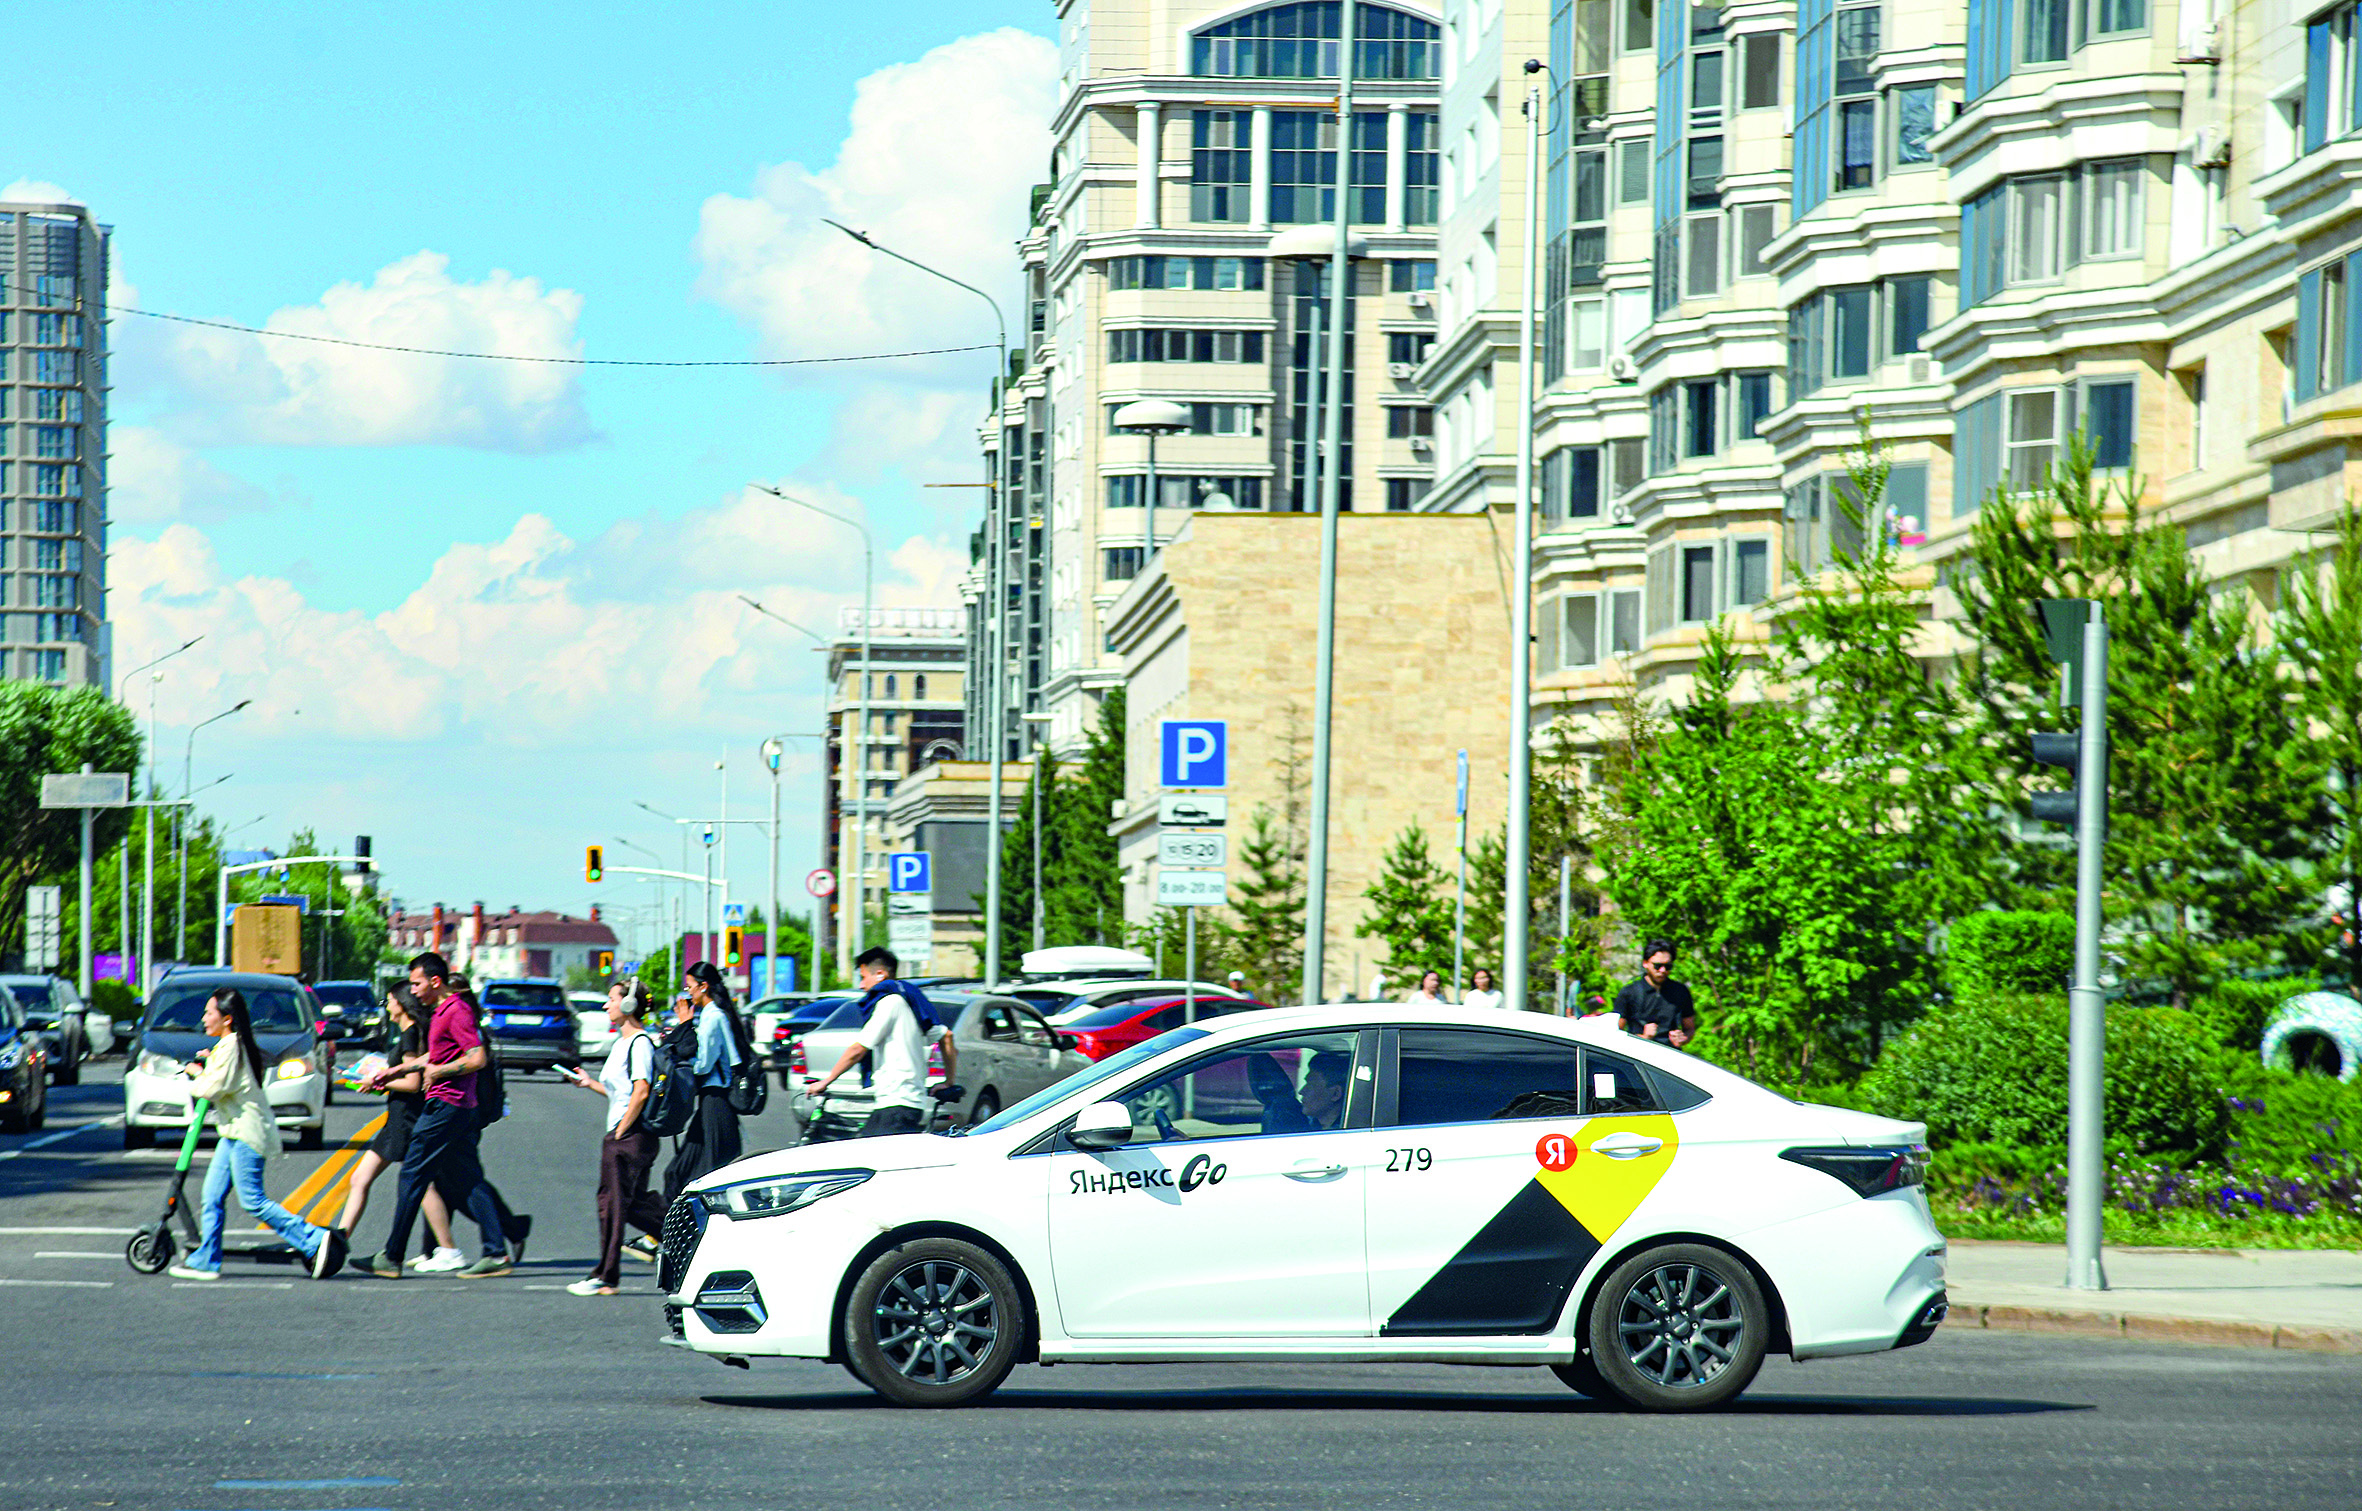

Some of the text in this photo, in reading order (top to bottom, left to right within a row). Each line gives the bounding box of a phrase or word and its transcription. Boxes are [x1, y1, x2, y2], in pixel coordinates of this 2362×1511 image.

[1178, 727, 1216, 780] P
[1197, 843, 1216, 856] 20
[897, 856, 922, 889] P
[1385, 1147, 1432, 1172] 279
[1545, 1138, 1566, 1165] Я
[1070, 1153, 1227, 1194] Яндекс Go
